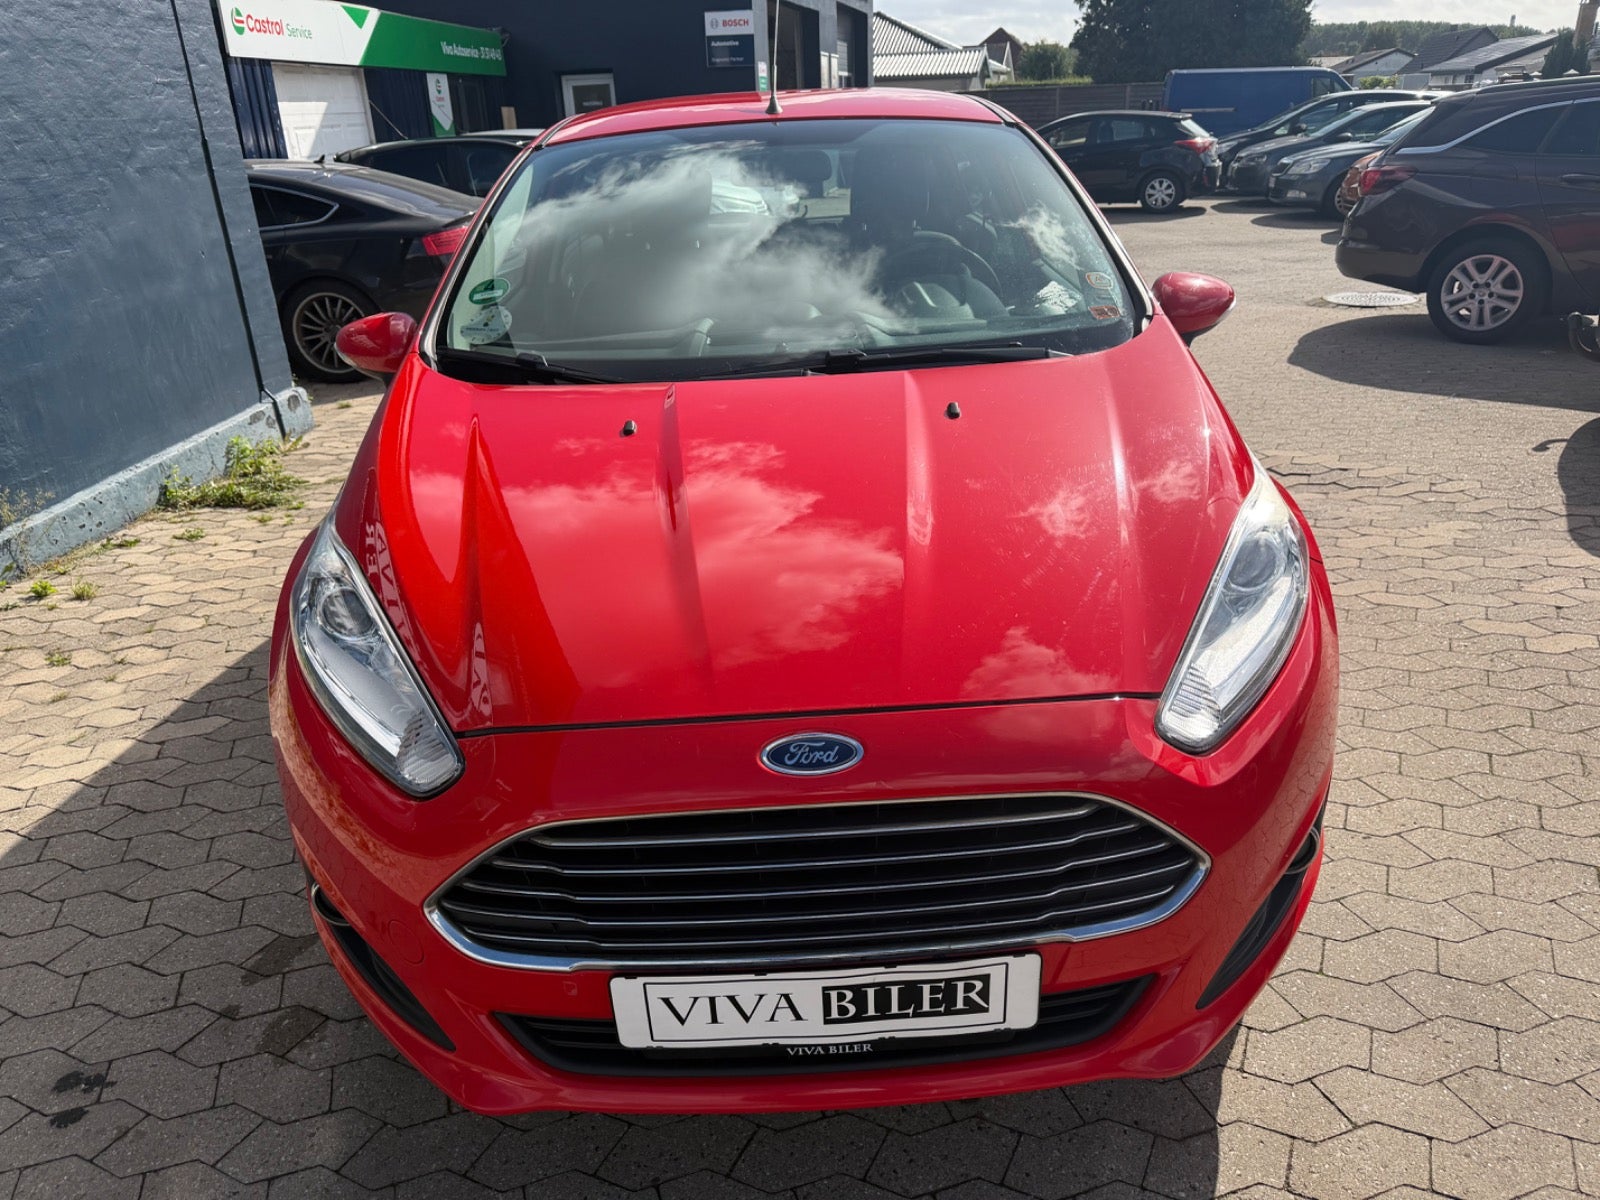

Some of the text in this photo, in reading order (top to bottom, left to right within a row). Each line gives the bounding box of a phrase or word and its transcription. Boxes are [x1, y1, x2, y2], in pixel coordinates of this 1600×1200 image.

[246, 14, 312, 39] Castrol Service
[722, 19, 749, 28] BOSCH
[784, 741, 839, 765] Ford
[658, 979, 990, 1027] VIVA BILER
[786, 1043, 873, 1056] VIVA BILER
